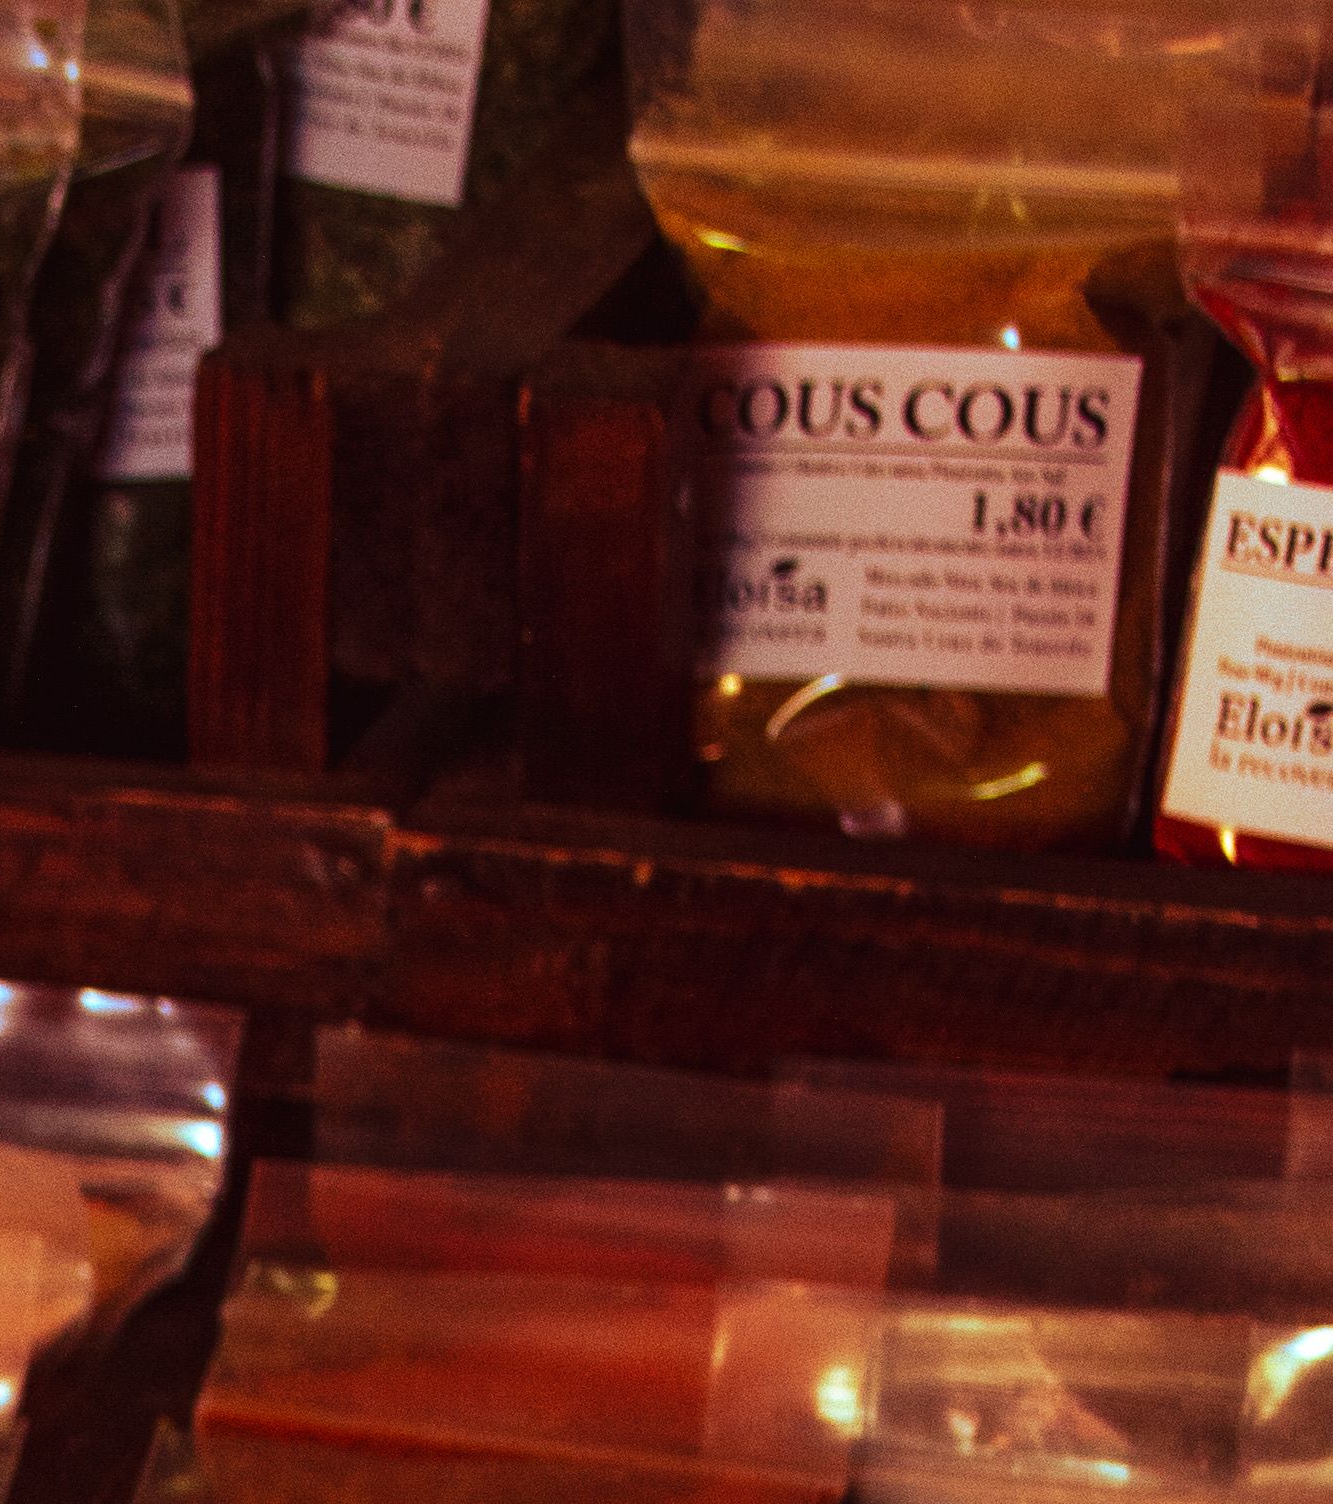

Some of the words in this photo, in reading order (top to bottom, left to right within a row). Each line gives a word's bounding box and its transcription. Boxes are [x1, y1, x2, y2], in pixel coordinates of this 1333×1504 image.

[696, 377, 885, 440] COUS
[902, 379, 1111, 448] COUS
[971, 490, 1069, 539] 1,80
